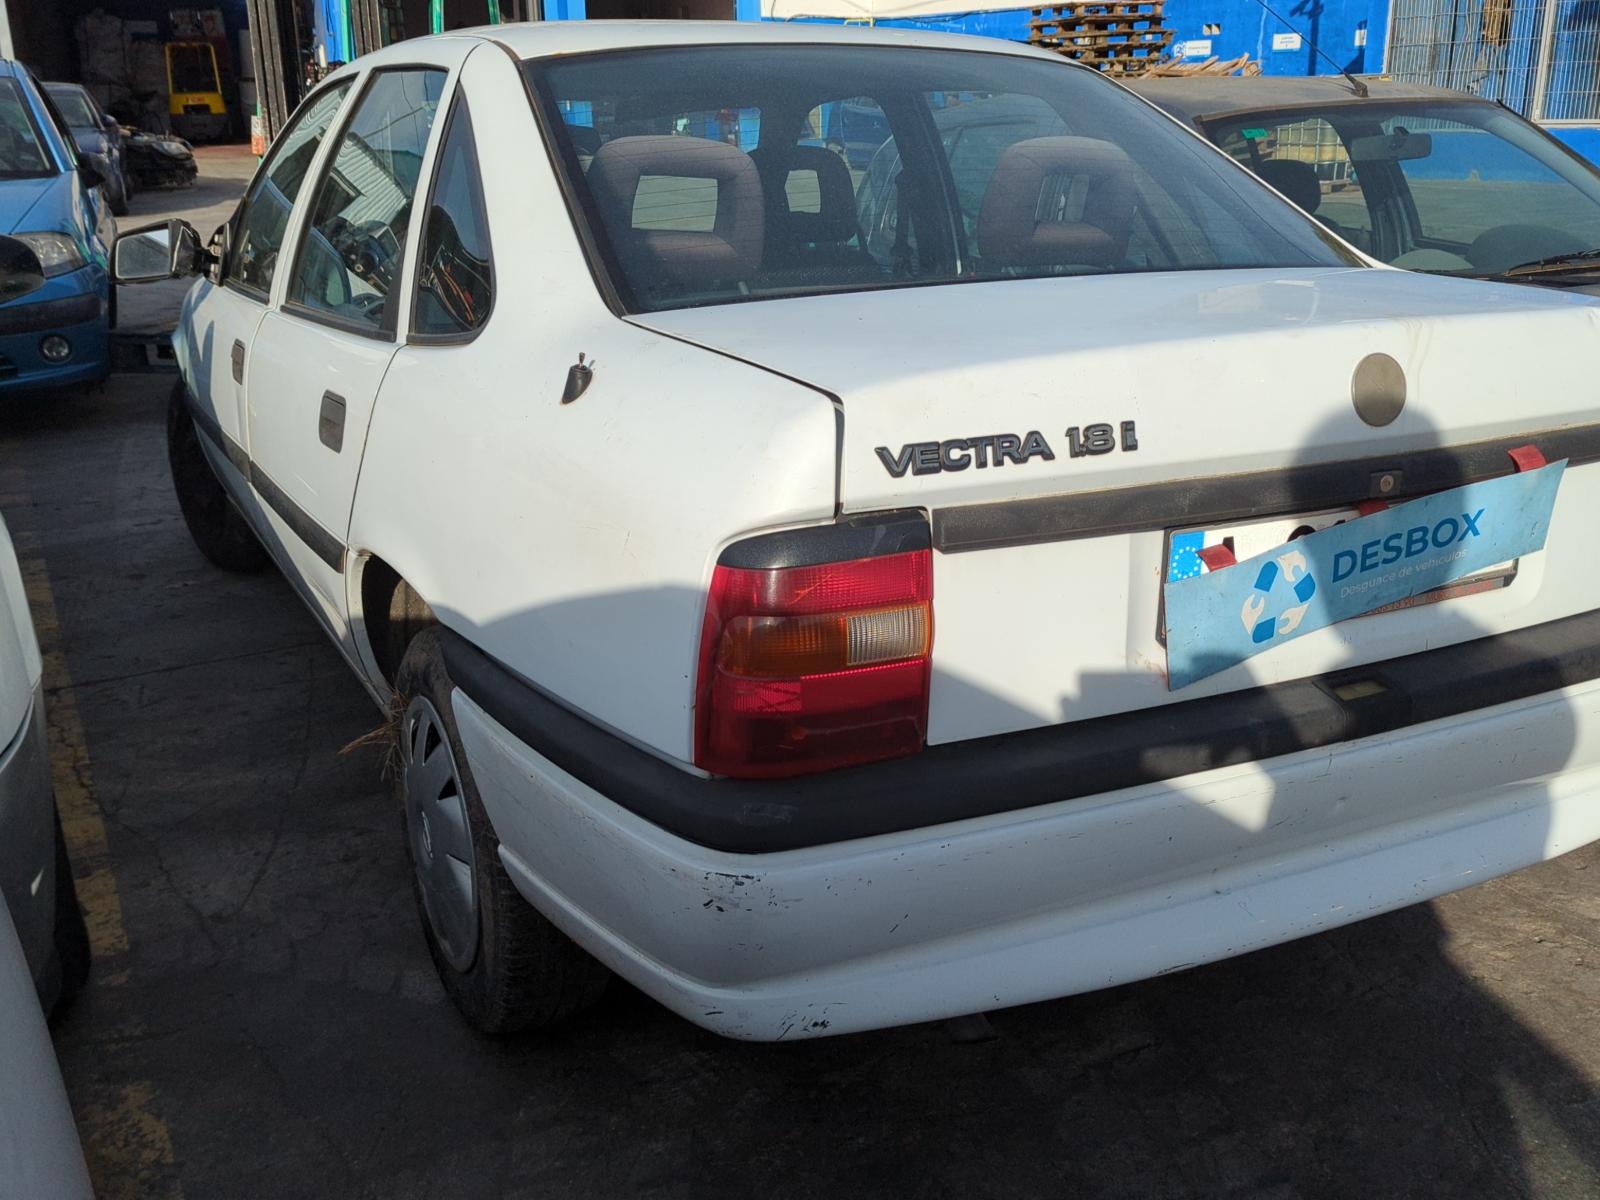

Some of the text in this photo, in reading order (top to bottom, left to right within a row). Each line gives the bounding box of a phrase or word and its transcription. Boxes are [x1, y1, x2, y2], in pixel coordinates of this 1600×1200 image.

[874, 430, 1055, 478] VECTRA
[1332, 508, 1485, 583] DESBOX
[1340, 572, 1397, 599] Desguace
[1398, 565, 1414, 579] de
